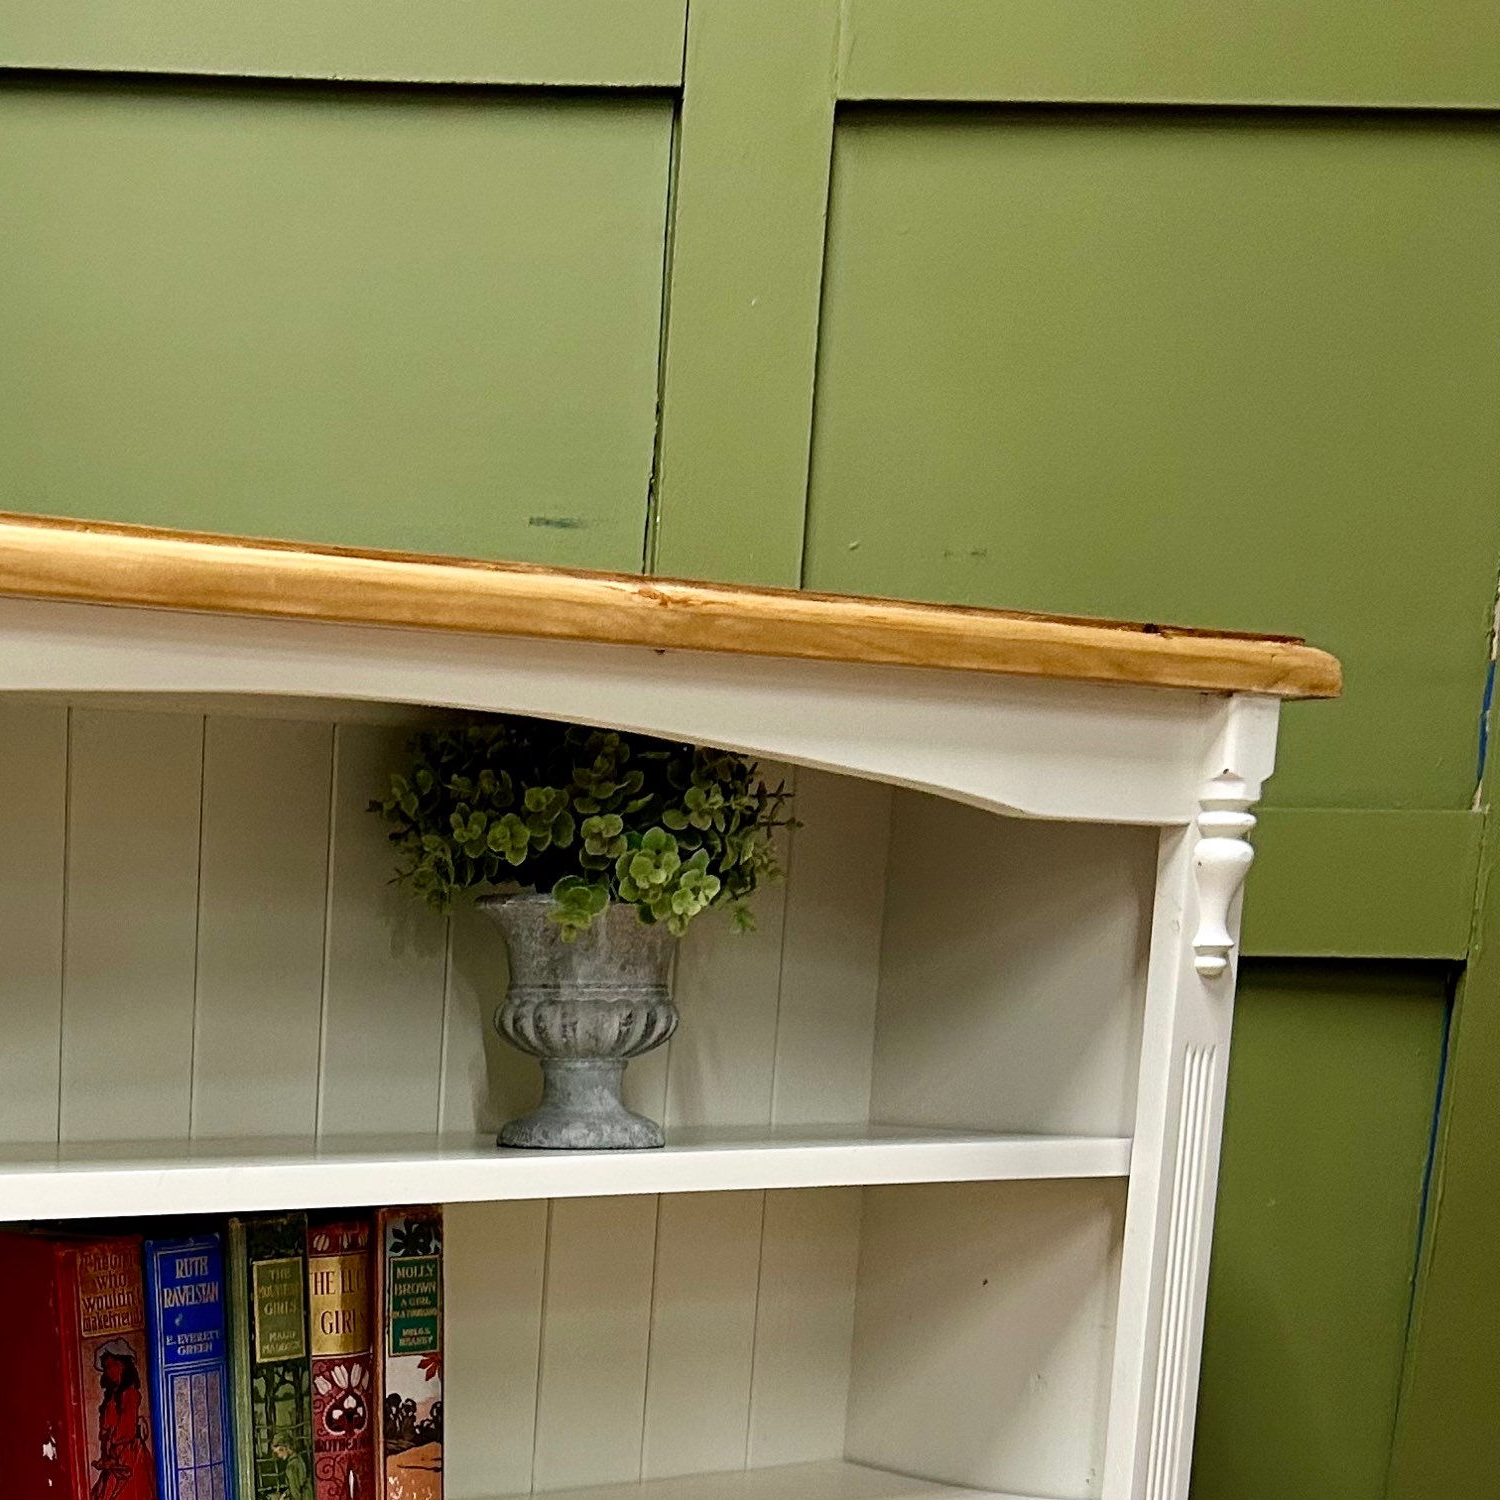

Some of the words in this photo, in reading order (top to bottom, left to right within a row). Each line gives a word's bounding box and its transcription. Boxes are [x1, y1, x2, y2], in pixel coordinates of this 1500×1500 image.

[175, 1256, 209, 1279] RUTH
[396, 1264, 436, 1279] MOLLY
[95, 1270, 127, 1293] who
[394, 1281, 436, 1297] BROWN
